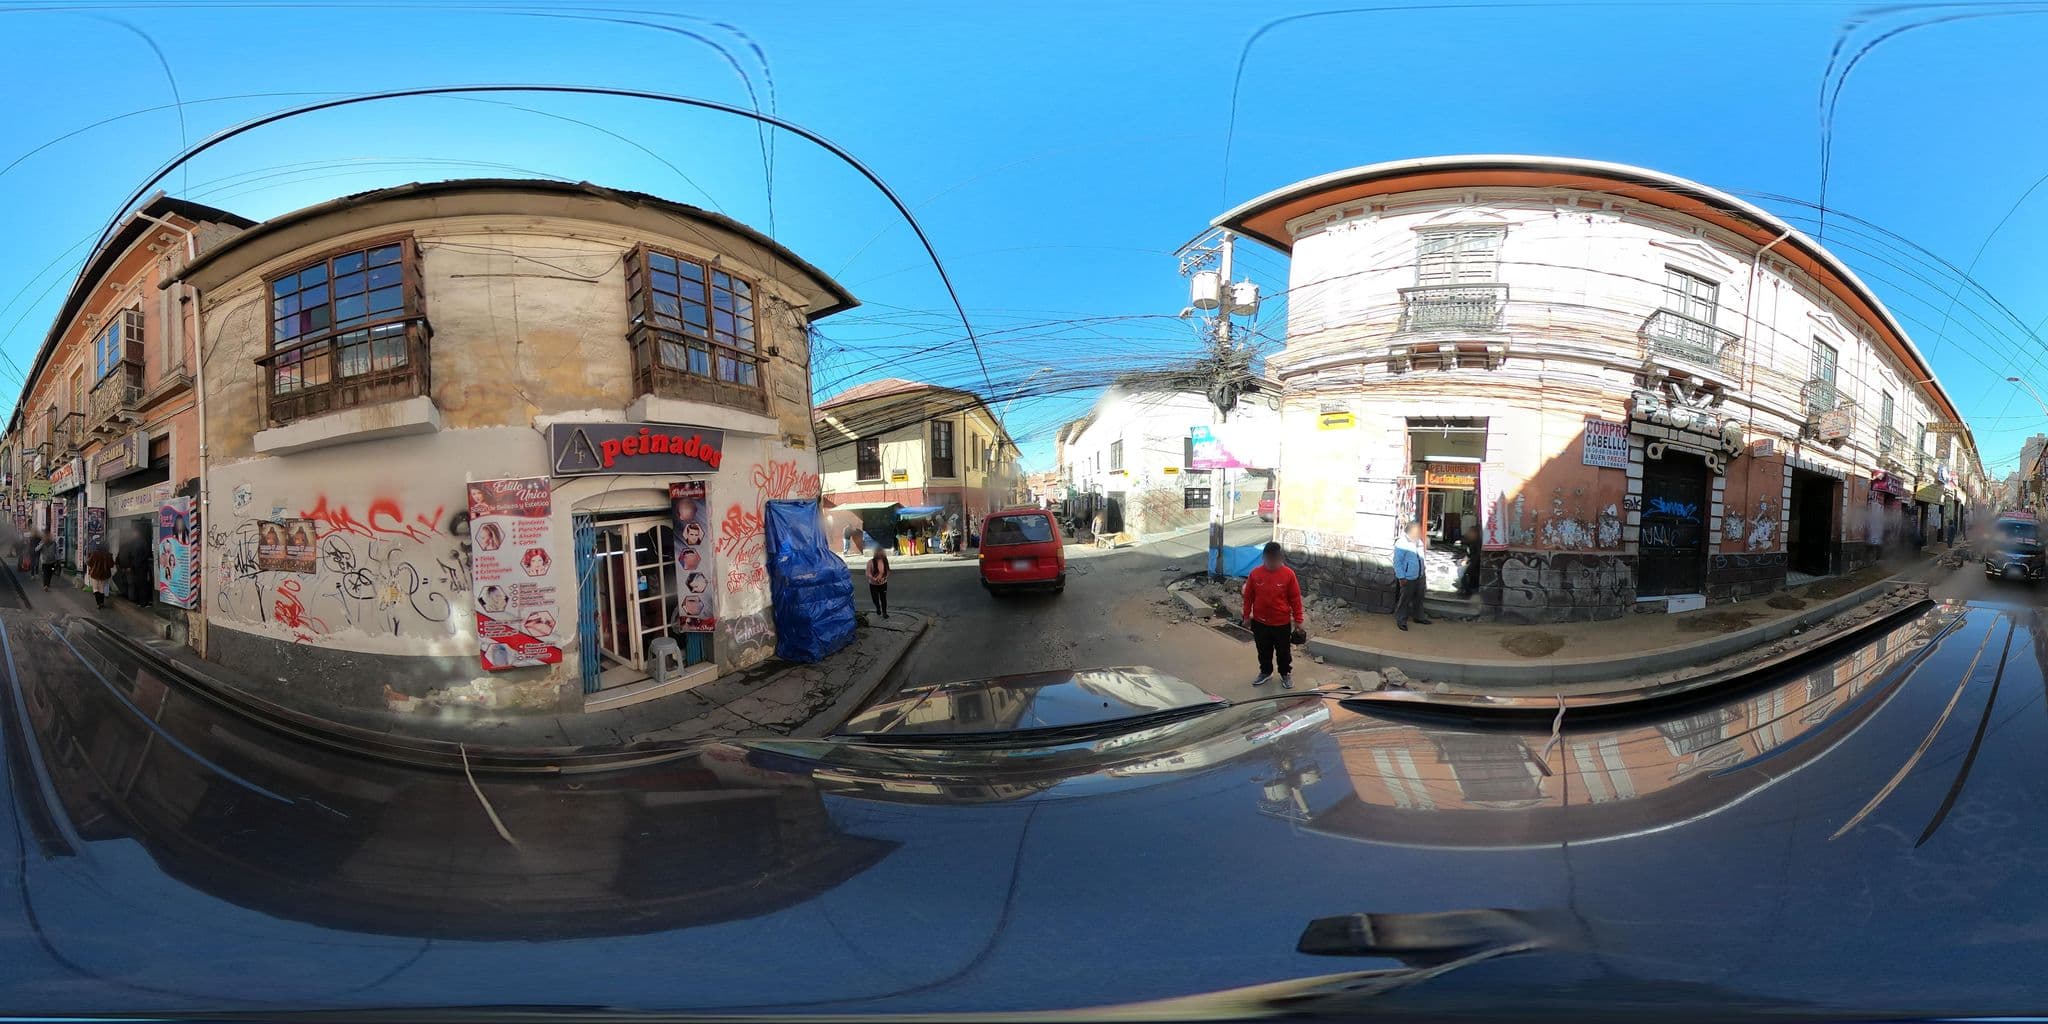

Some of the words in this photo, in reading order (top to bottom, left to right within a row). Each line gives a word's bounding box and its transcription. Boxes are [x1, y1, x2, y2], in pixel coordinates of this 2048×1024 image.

[1587, 420, 1629, 438] COMPRO
[600, 426, 722, 469] peinados
[1586, 435, 1628, 451] CABELLLO
[493, 481, 523, 493] Estilo
